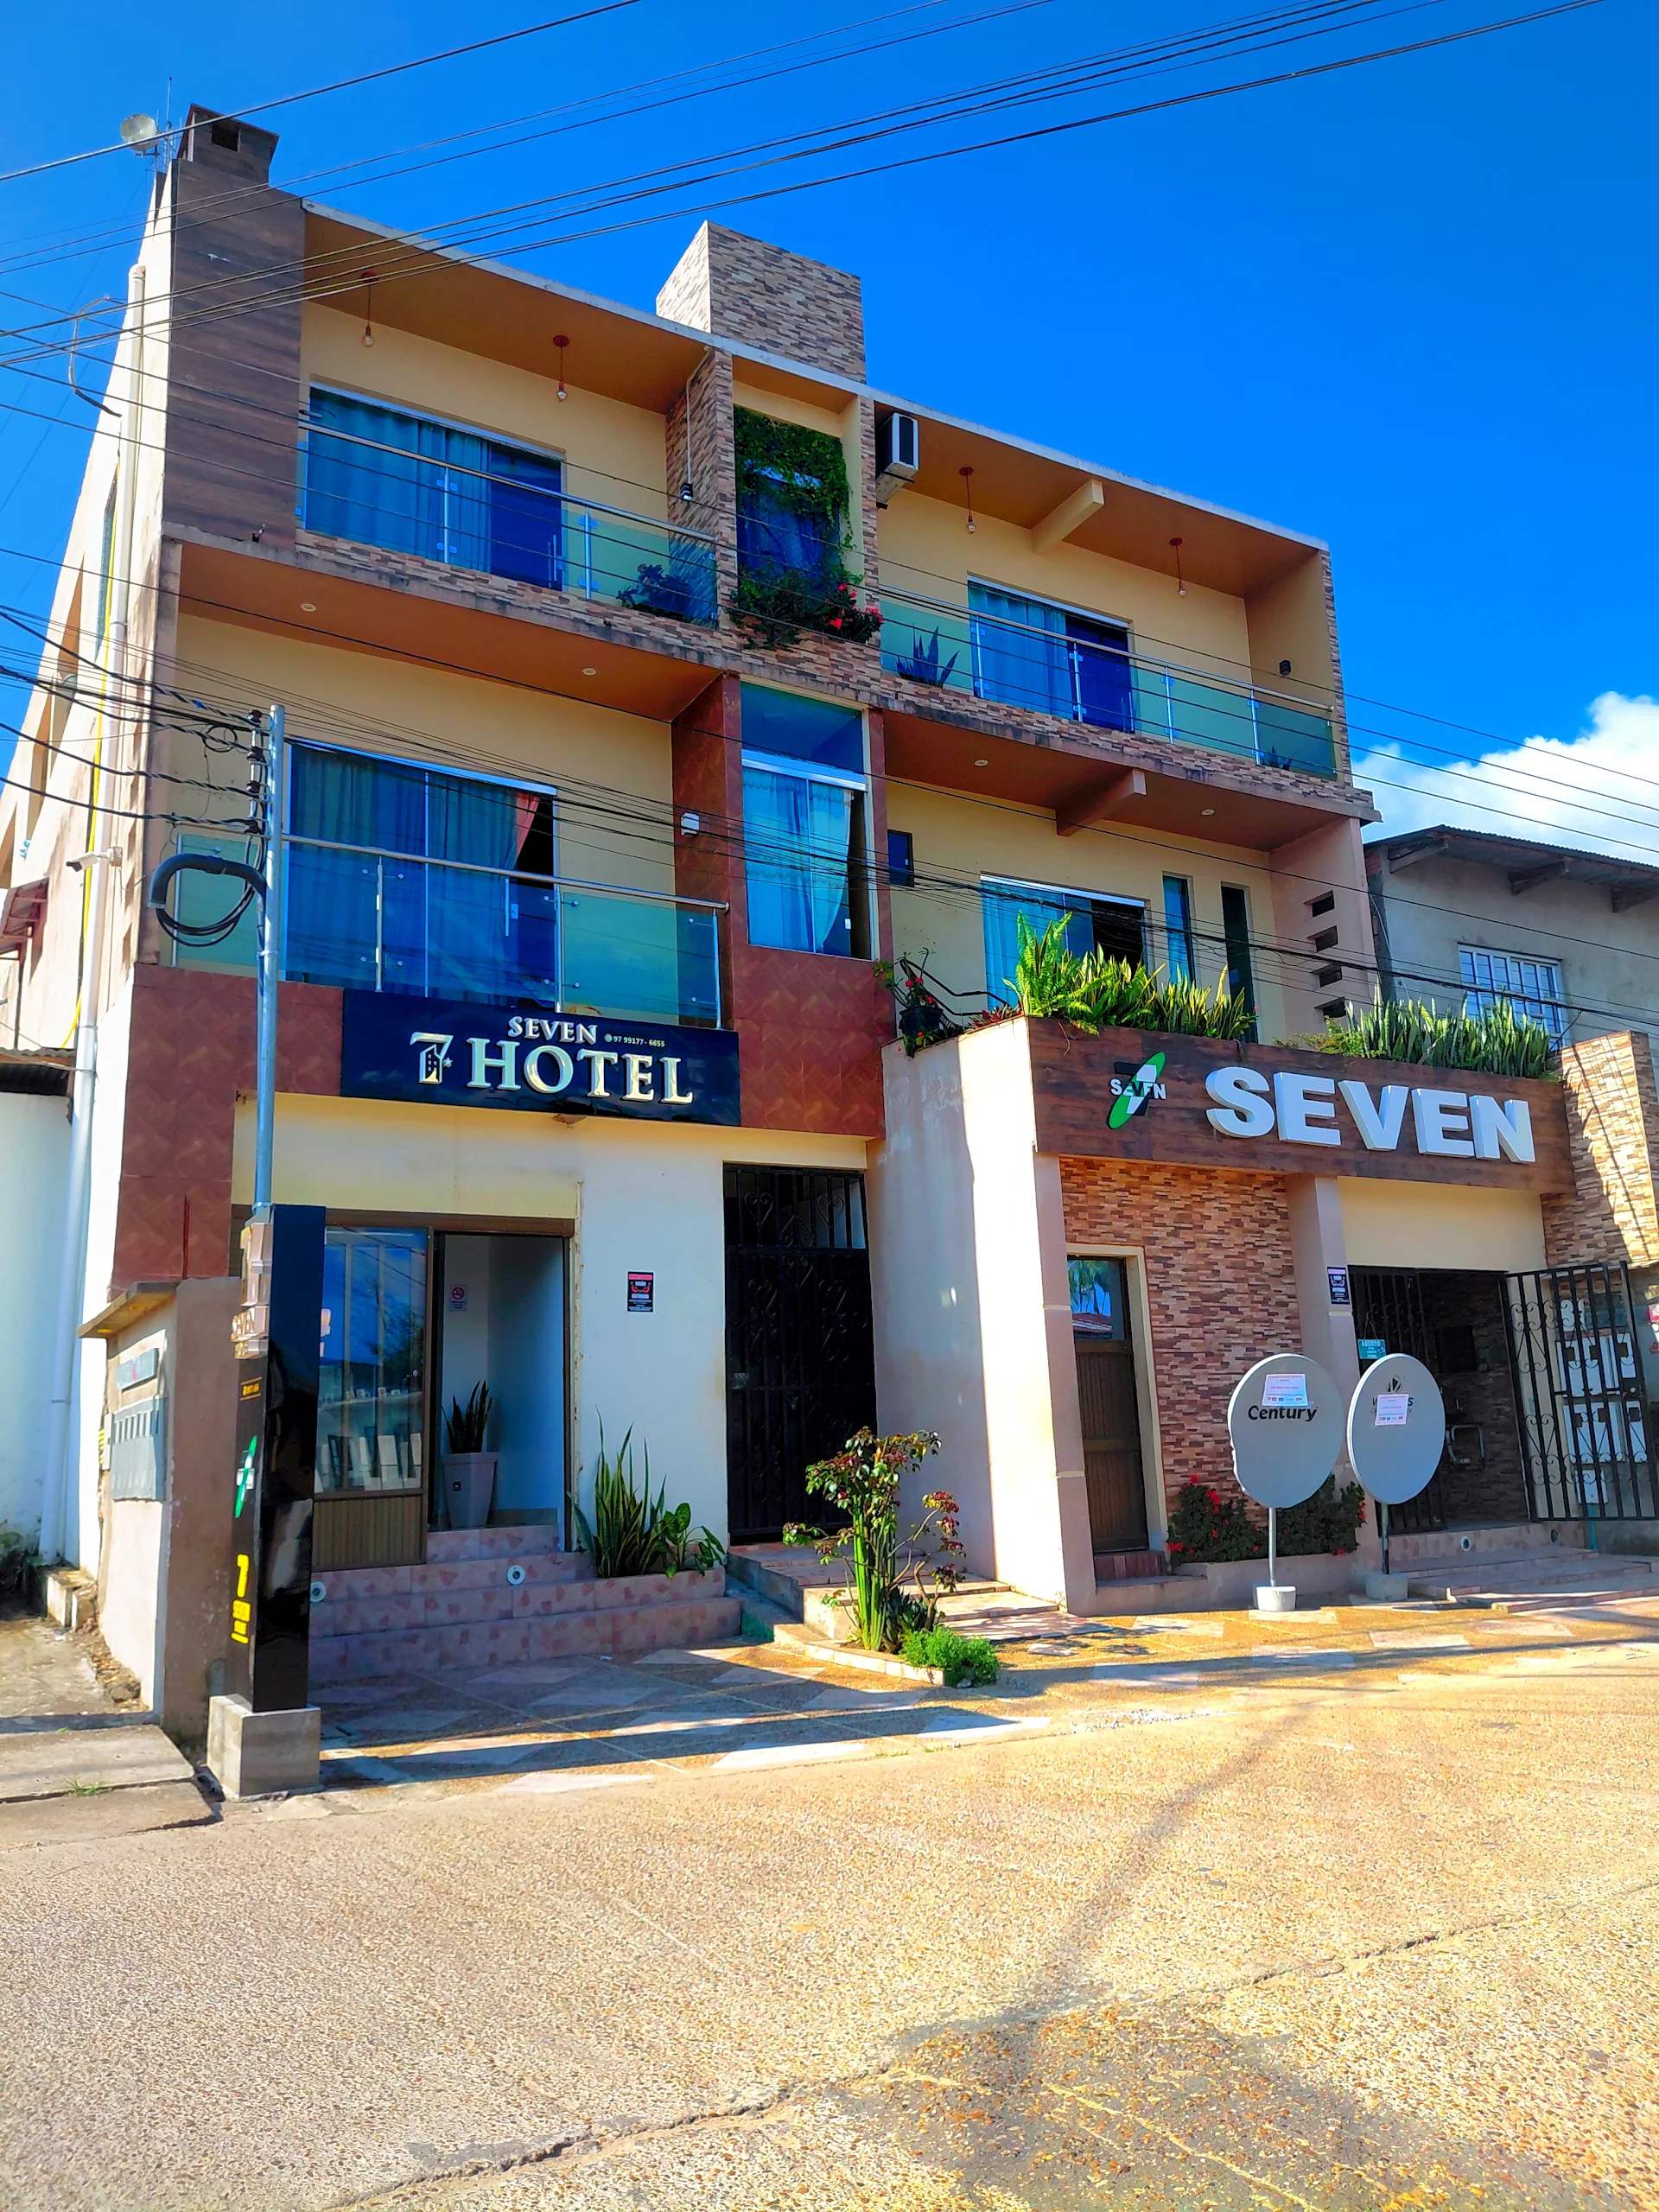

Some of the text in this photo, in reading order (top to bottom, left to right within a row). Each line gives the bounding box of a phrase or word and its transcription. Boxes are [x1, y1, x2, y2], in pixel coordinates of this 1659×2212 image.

[507, 1016, 598, 1045] SEVEN
[648, 1039, 665, 1047] 6655
[467, 1037, 694, 1104] HOTEL
[1205, 1066, 1535, 1163] SEVEN
[1248, 1405, 1319, 1422] Century
